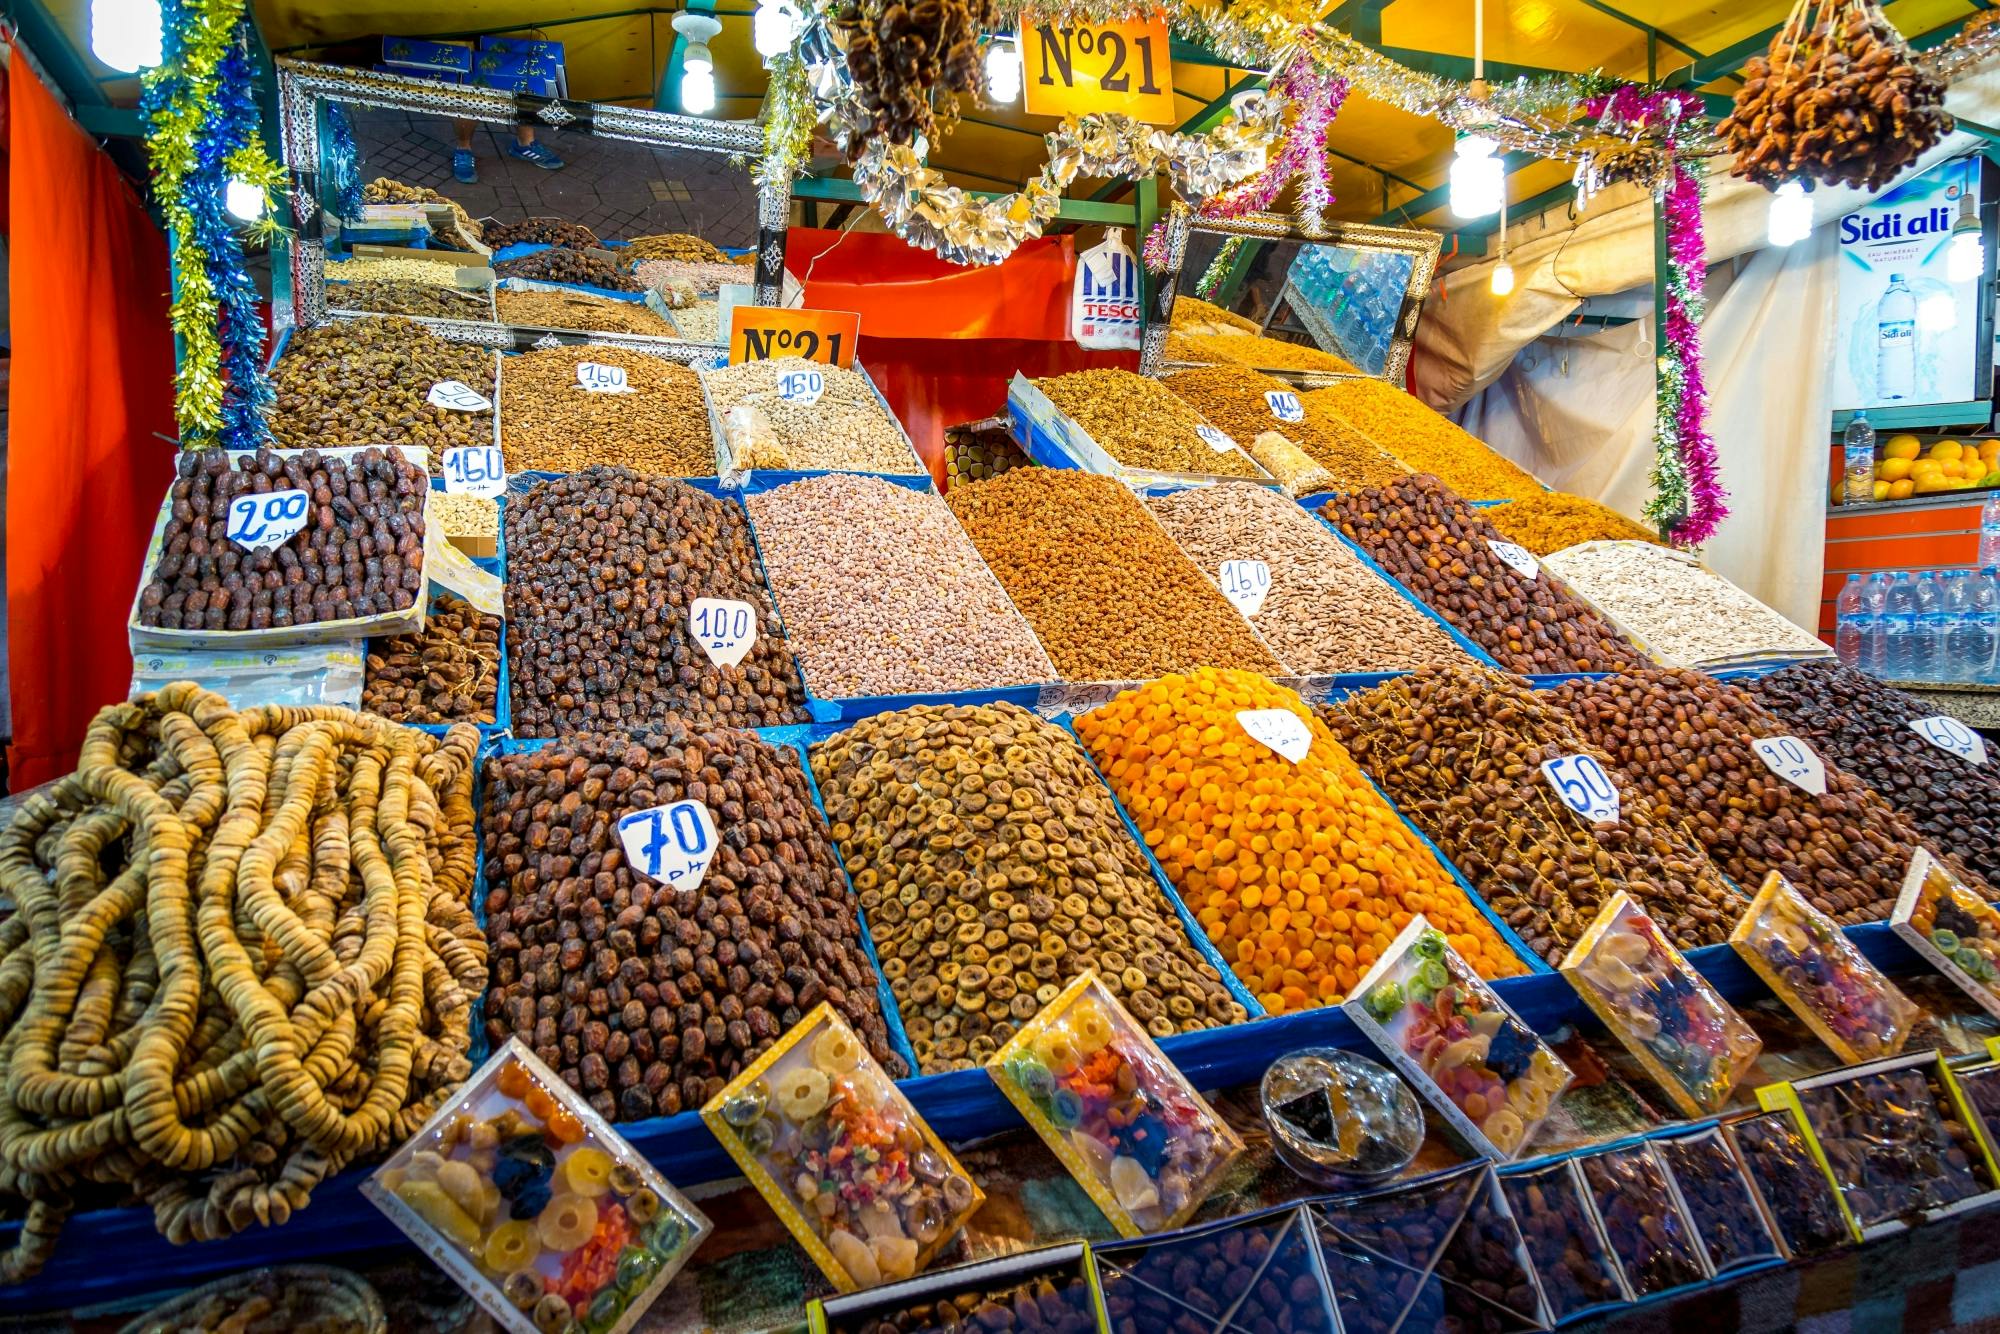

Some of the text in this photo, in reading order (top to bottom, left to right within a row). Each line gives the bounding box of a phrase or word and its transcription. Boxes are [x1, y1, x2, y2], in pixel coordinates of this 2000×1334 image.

[1840, 206, 1951, 245] Sidi ali
[581, 364, 623, 386] 160
[778, 373, 821, 399] 160
[446, 447, 503, 483] 160
[228, 493, 307, 542] 200
[1495, 544, 1529, 561] 160
[1225, 561, 1267, 592] 160
[696, 607, 748, 639] 100
[1925, 718, 1972, 748] 60
[1761, 739, 1804, 767] 90
[1548, 755, 1613, 812] 50
[619, 804, 708, 876] 70
[669, 861, 706, 880] DH
